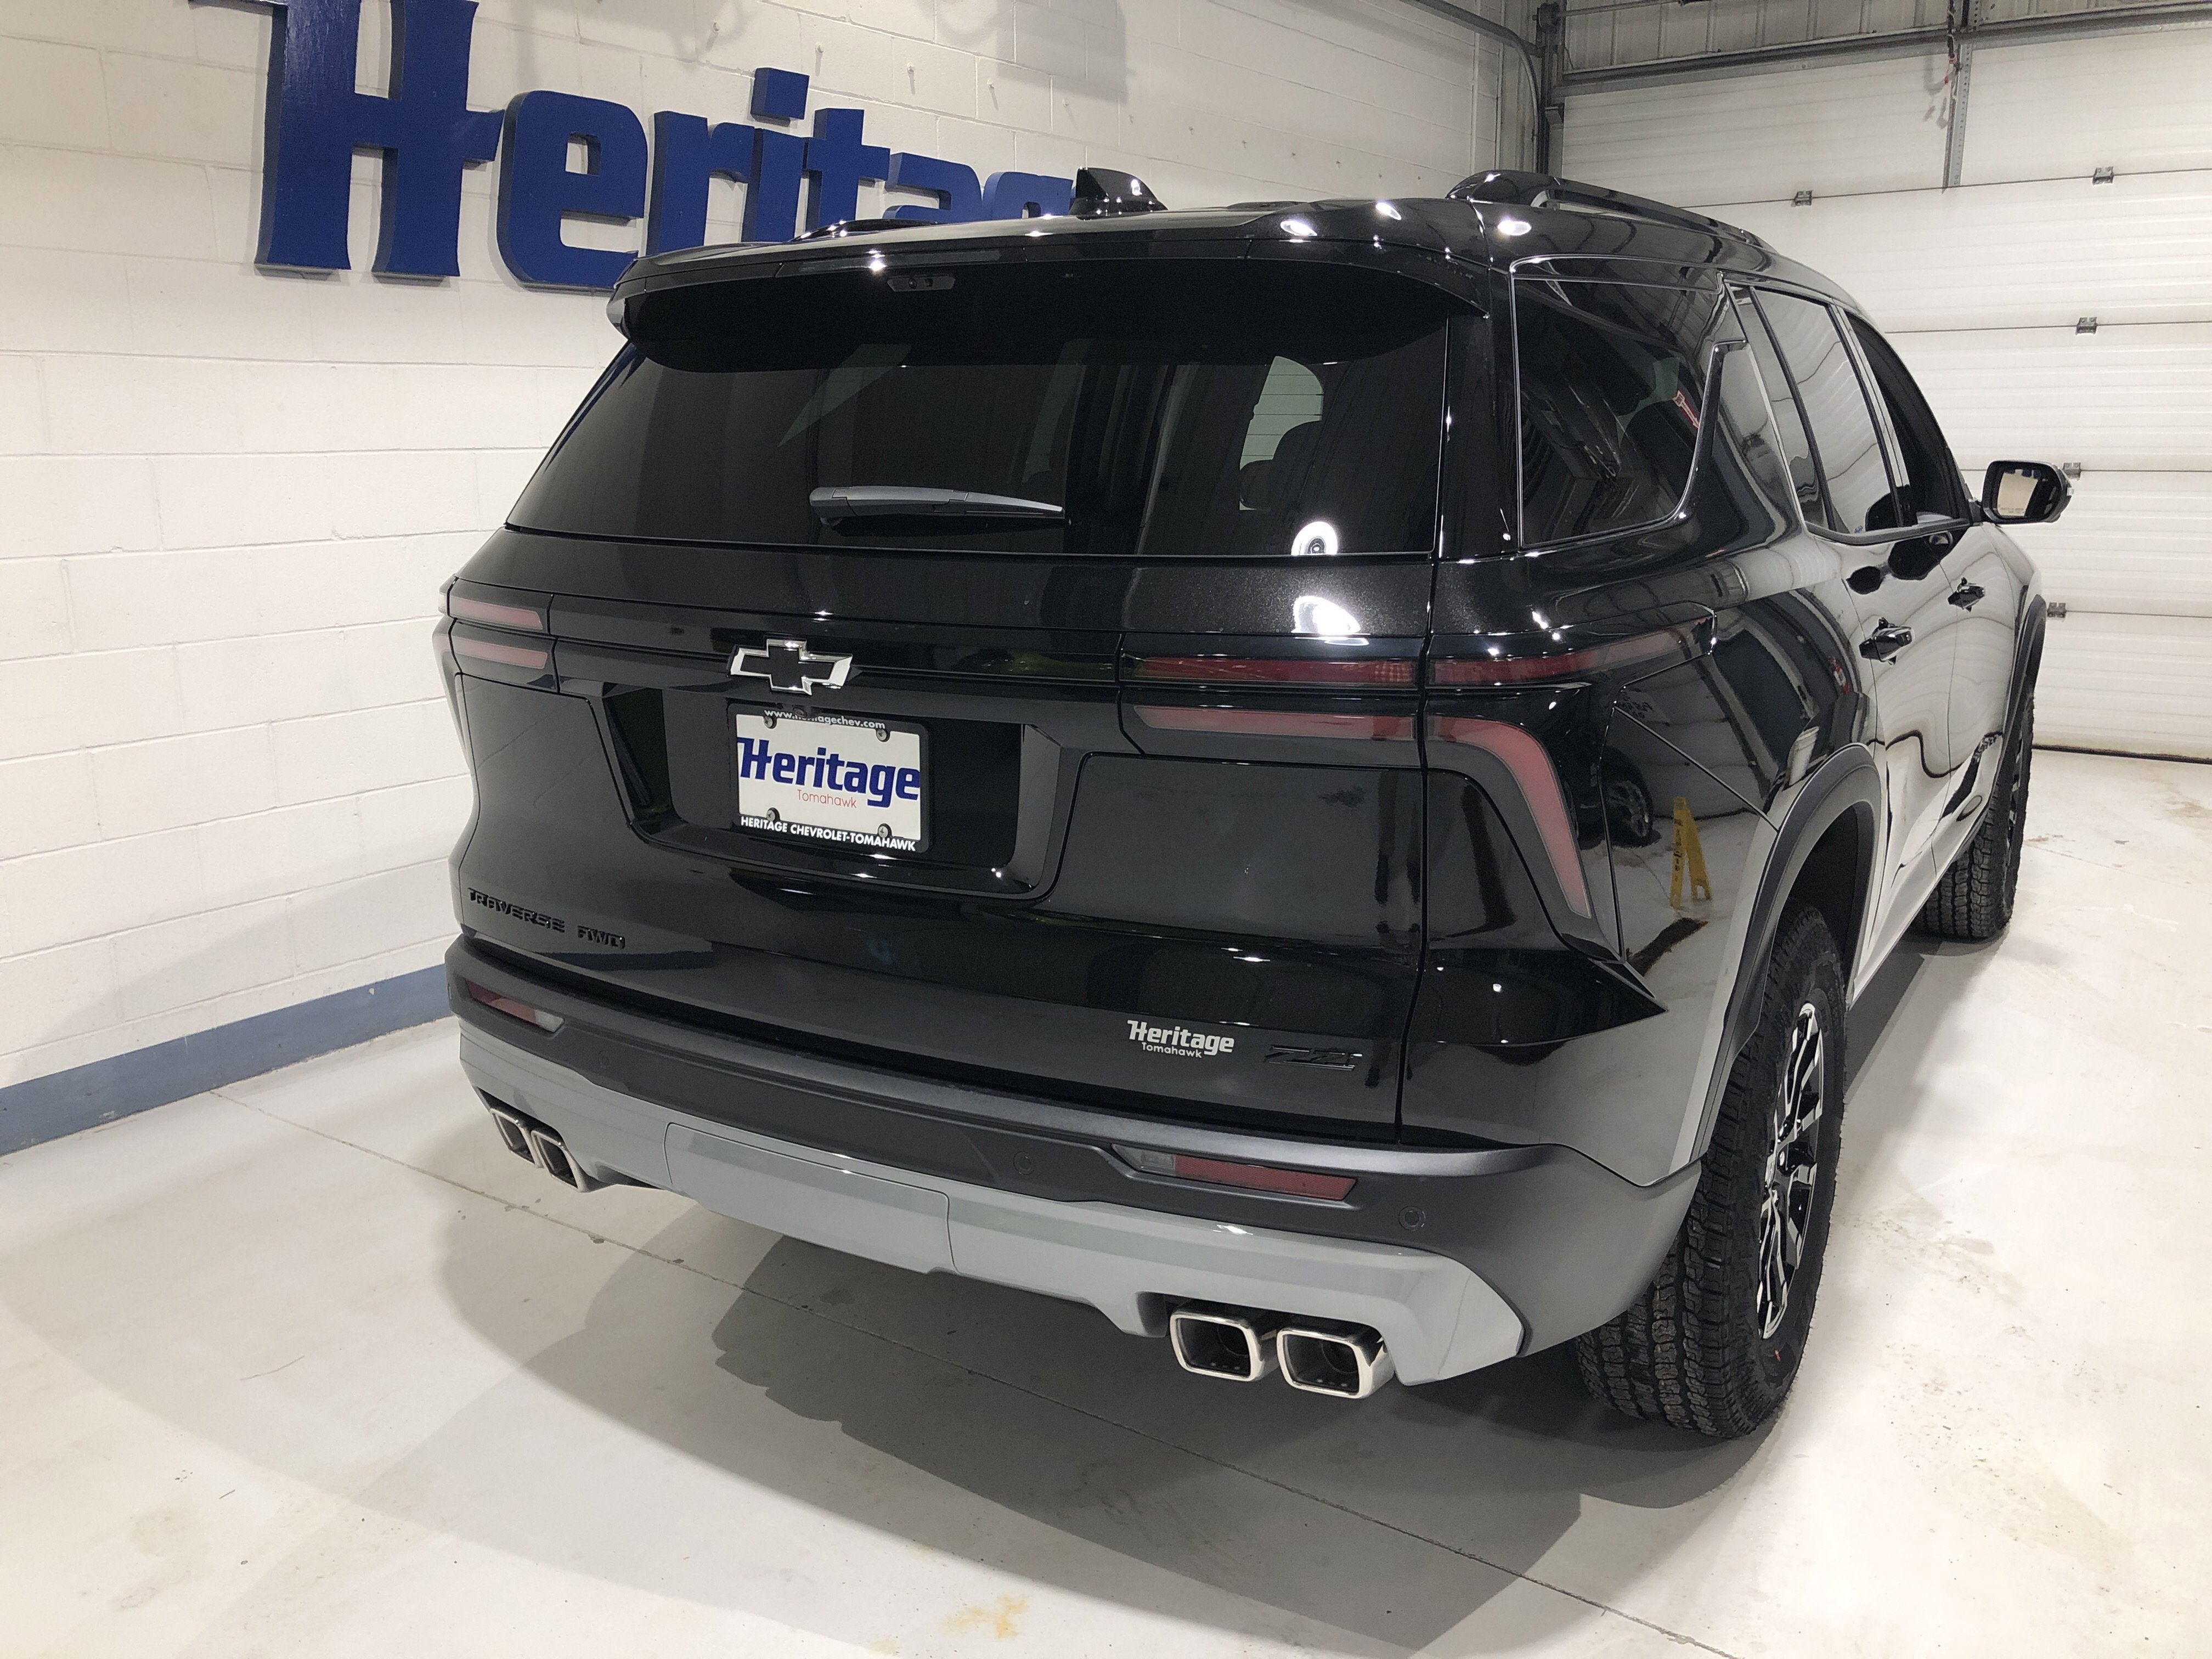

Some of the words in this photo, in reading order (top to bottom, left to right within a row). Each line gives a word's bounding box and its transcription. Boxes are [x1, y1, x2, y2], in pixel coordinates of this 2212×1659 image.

[737, 736, 921, 808] Heritage
[797, 789, 857, 809] Tomahawk
[741, 816, 788, 833] HERITAGE
[790, 823, 916, 851] CHEVROLET-TOMAHAWK
[467, 887, 565, 933] TRAVERSE
[1127, 1019, 1235, 1056] Heritage
[1141, 1042, 1203, 1059] Tomahawk
